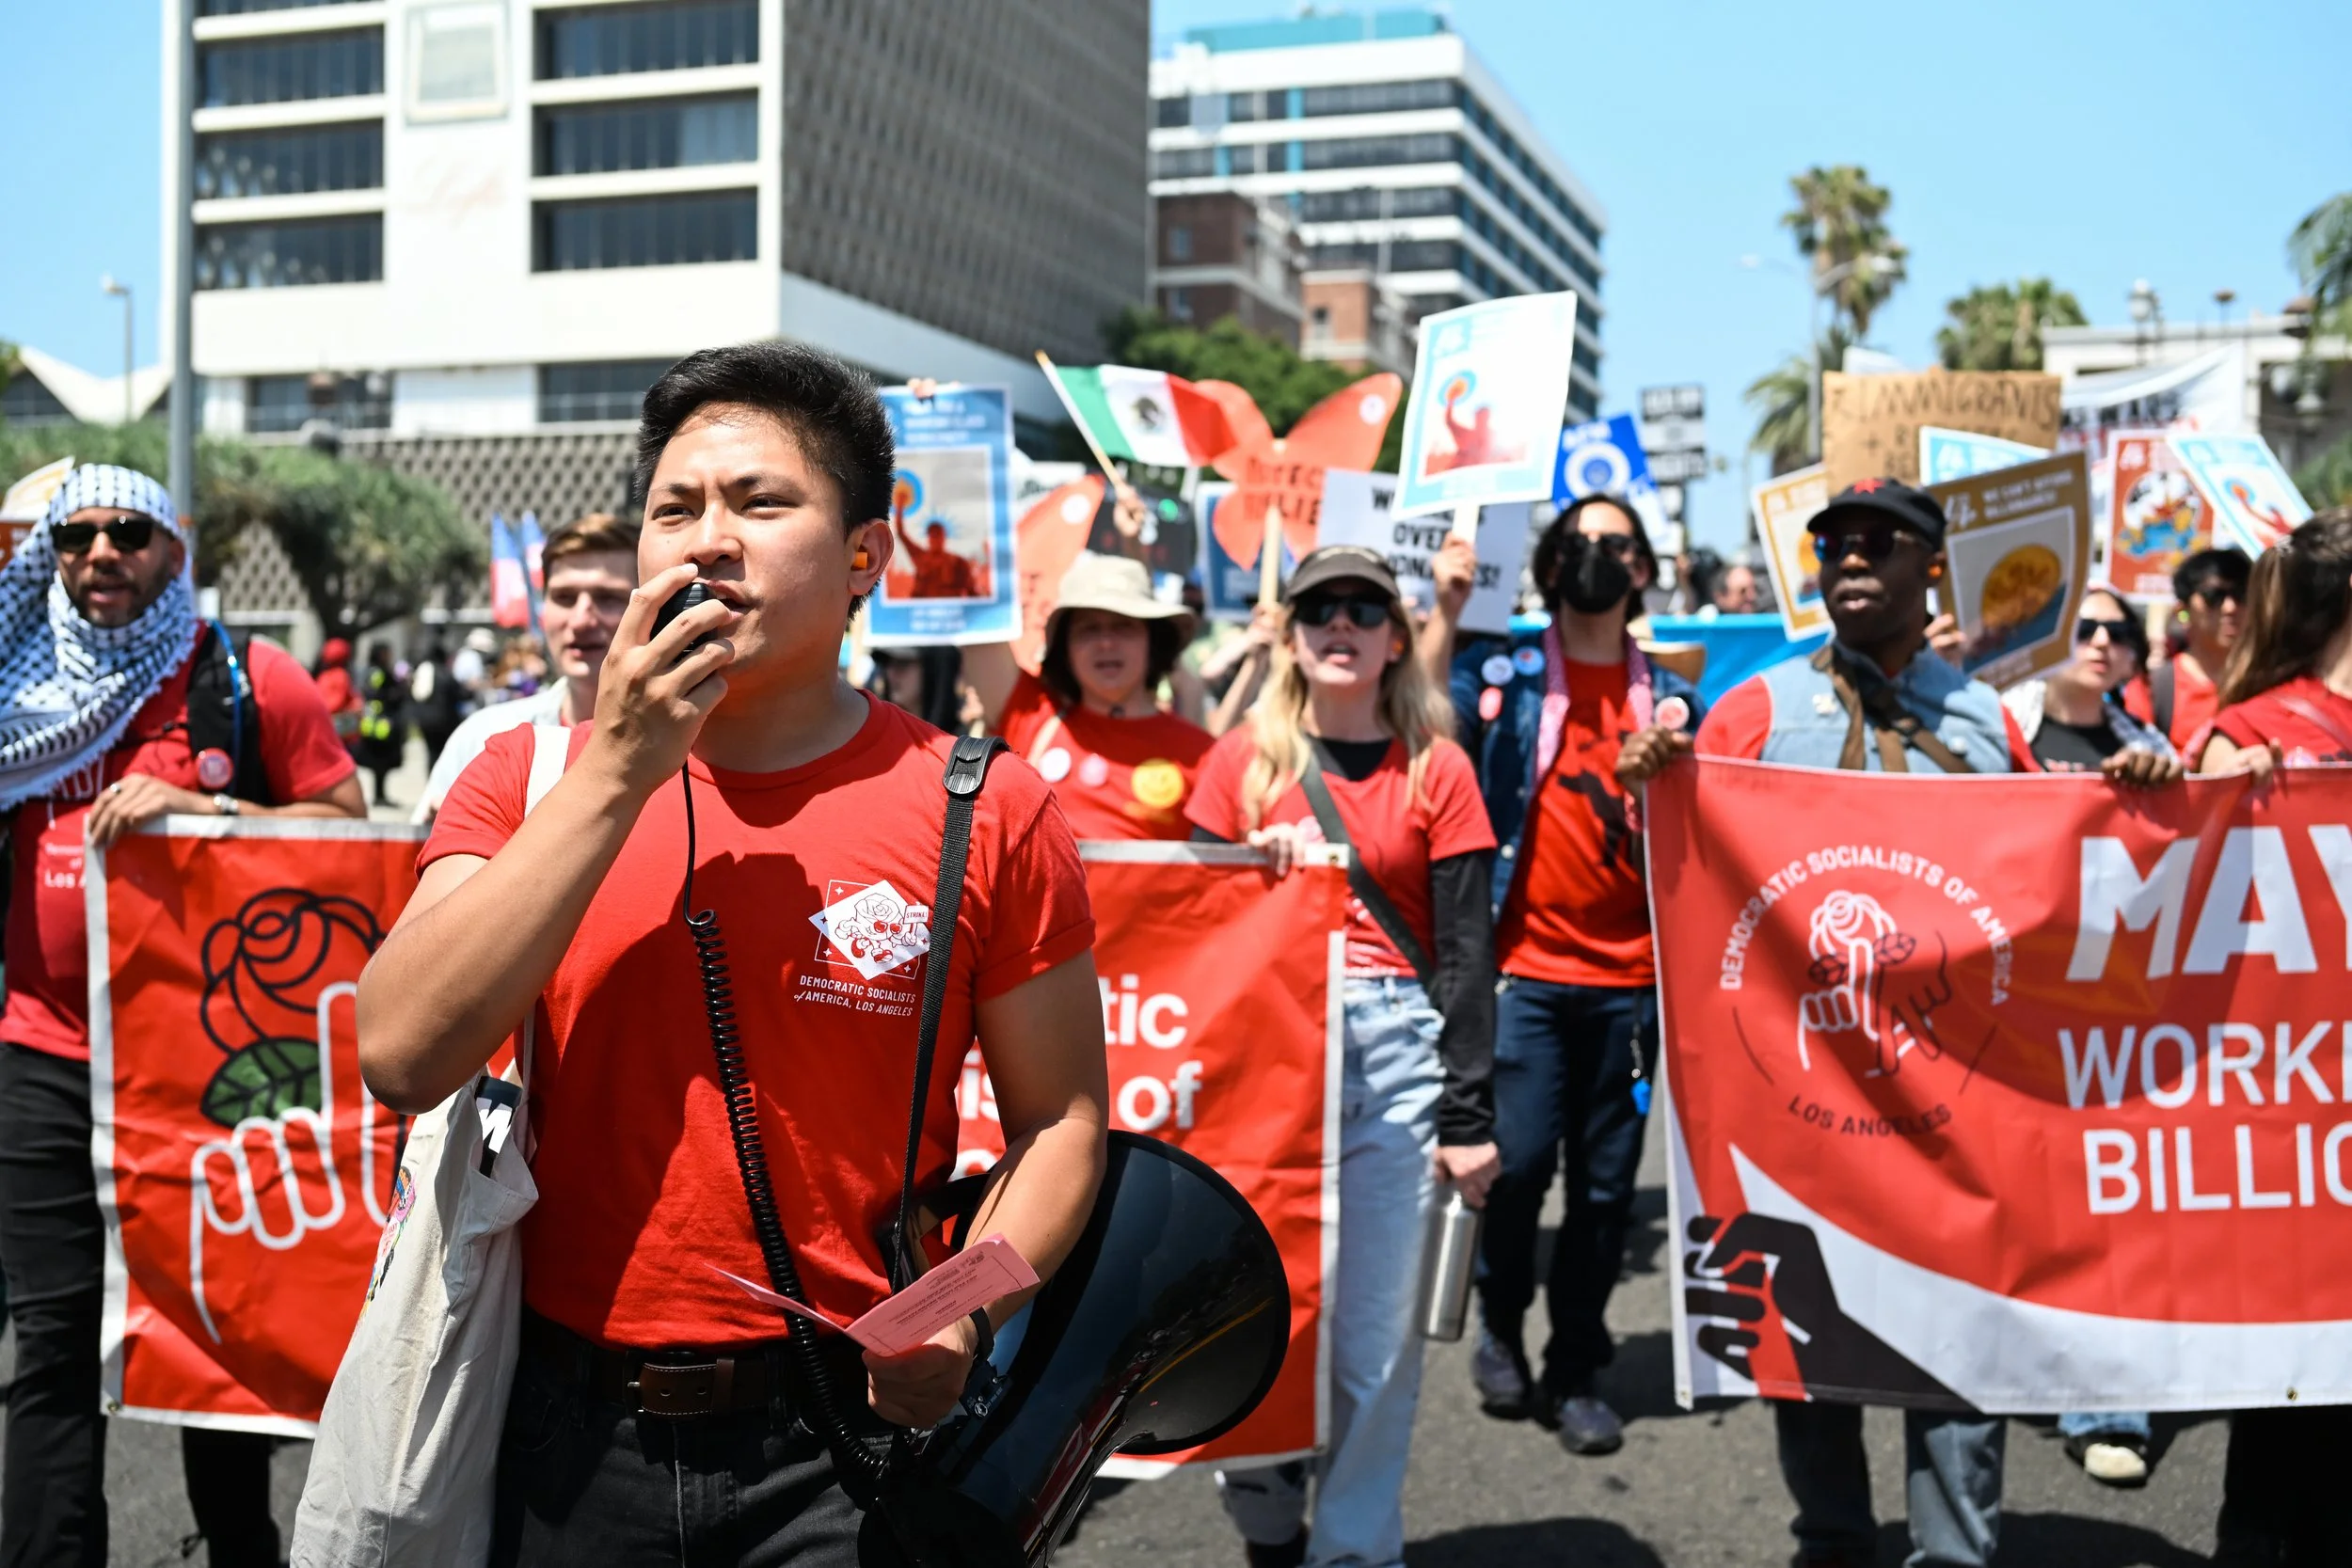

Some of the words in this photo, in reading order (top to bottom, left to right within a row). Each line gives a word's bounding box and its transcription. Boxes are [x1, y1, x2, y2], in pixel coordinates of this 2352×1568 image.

[1720, 860, 1808, 990] DEMOCRATIC
[1805, 846, 1946, 887] SOCIALISTS
[1943, 876, 1980, 906] OF
[1969, 906, 2014, 1006] AMERICA
[793, 990, 806, 1003] of
[804, 991, 852, 1008] AMERICA,
[855, 1000, 875, 1012] LOS
[875, 1004, 914, 1017] ANGELES
[800, 974, 865, 996] DEMOCRATIC
[866, 987, 916, 1004] SOCIALISTS
[1117, 1060, 1203, 1132] of
[1788, 1095, 1835, 1131] LOS
[1839, 1103, 1952, 1137] ANGELES
